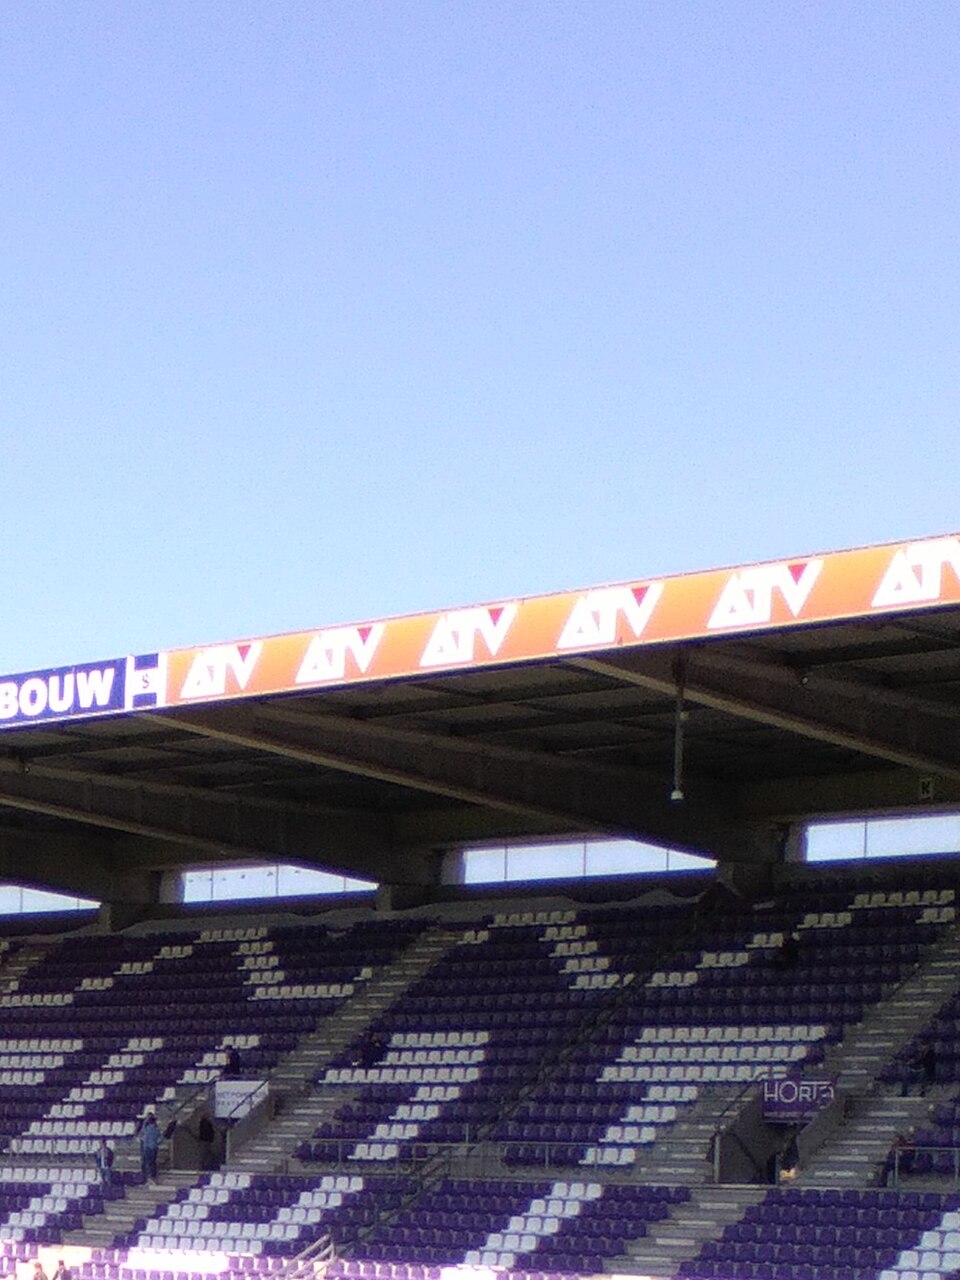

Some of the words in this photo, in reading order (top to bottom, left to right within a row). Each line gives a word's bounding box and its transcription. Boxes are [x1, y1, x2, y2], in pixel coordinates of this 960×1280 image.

[555, 582, 664, 650] ATV
[707, 560, 824, 629] ATV
[294, 623, 387, 683] ATV
[419, 601, 520, 668] ATV
[179, 641, 264, 699] ATV
